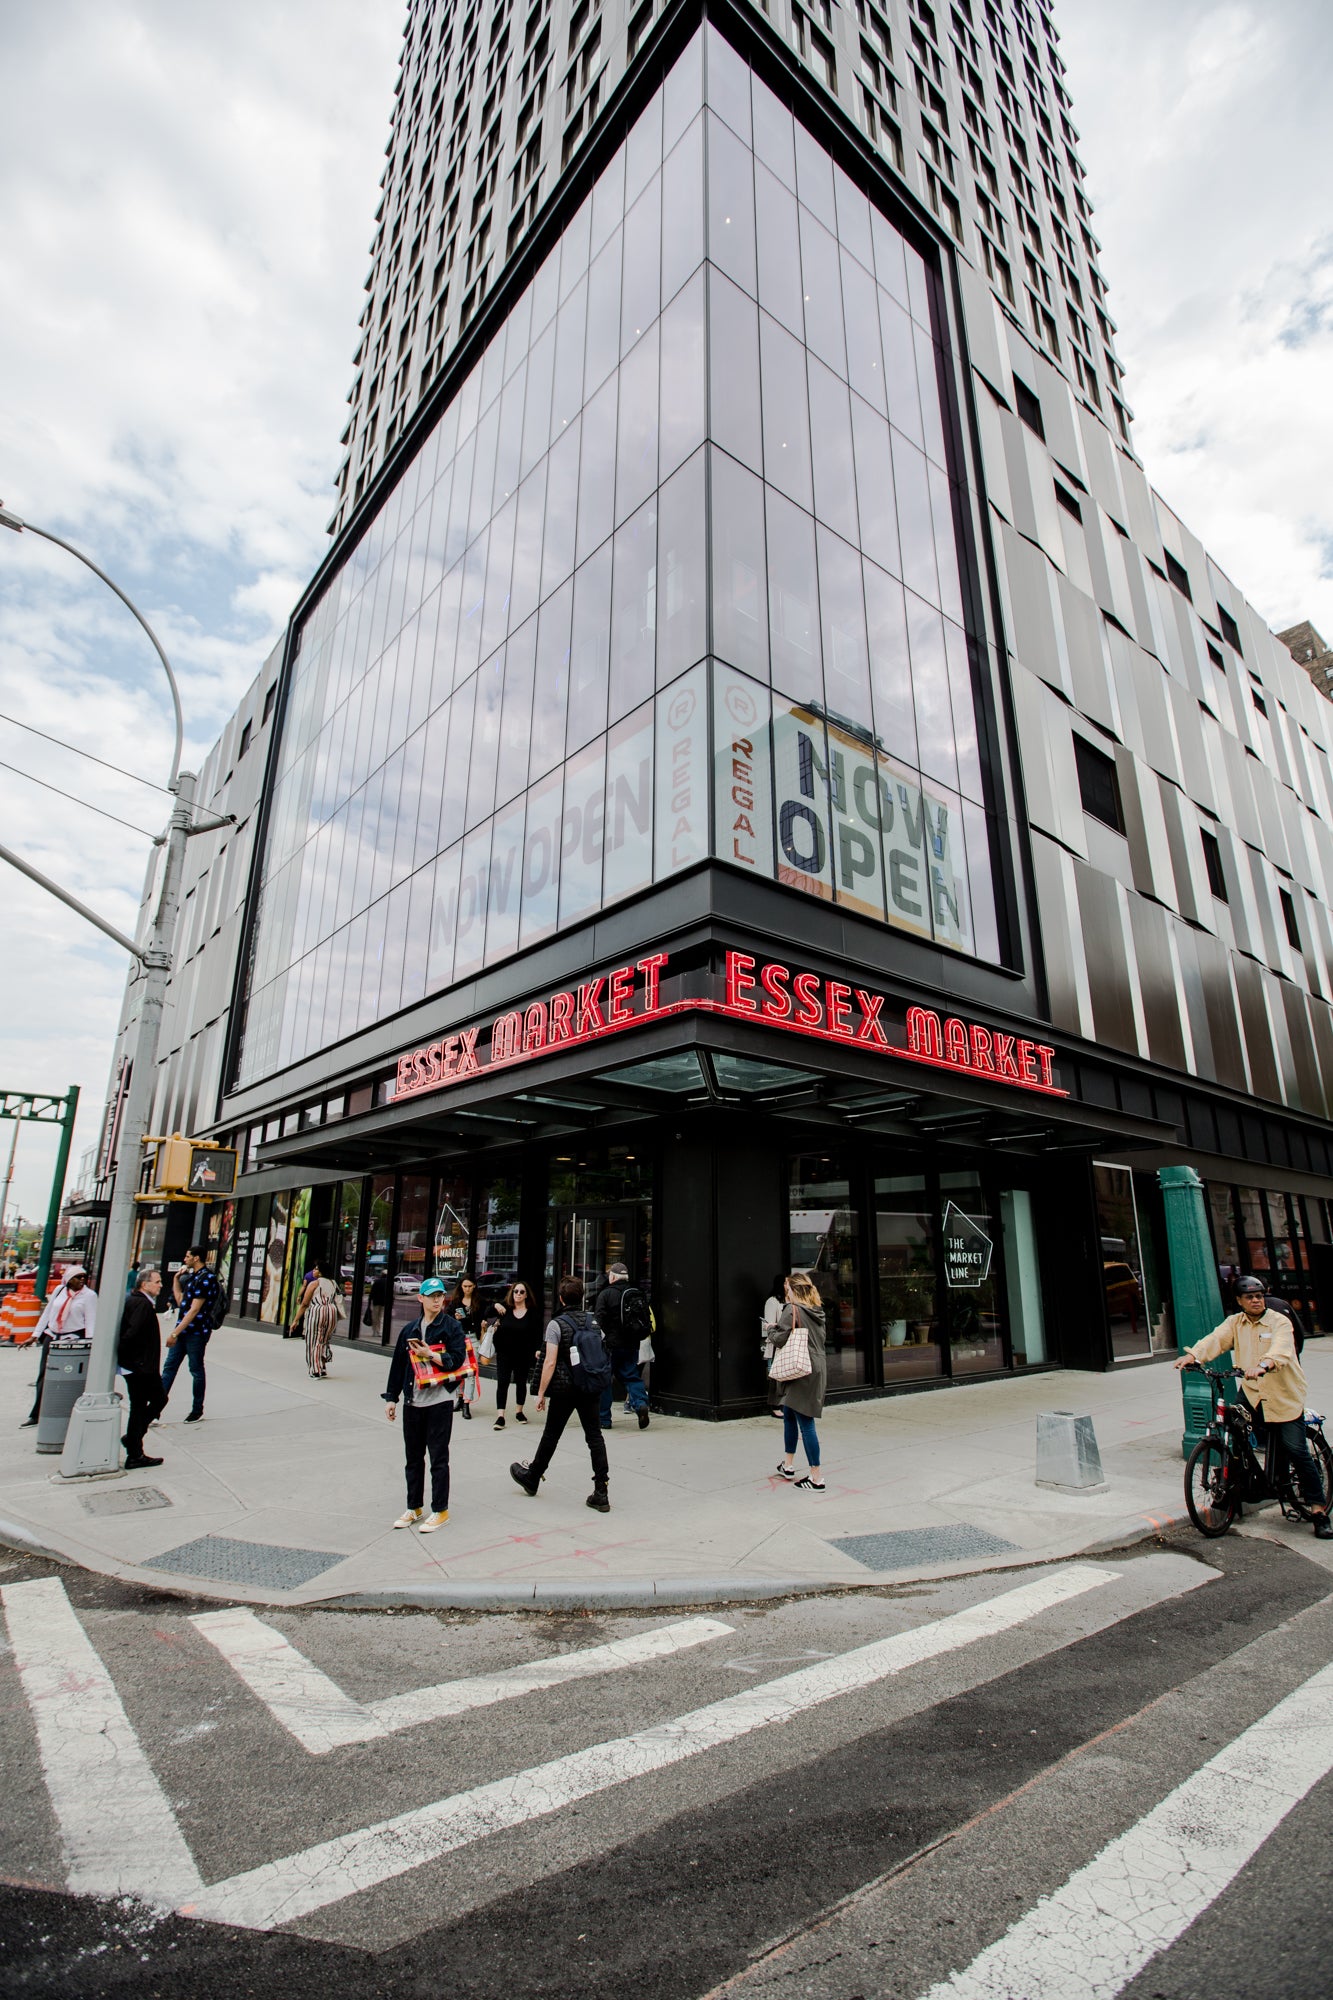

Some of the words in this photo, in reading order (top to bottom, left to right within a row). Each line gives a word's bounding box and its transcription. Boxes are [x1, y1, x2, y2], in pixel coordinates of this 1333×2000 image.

[432, 846, 517, 955] NOW
[523, 756, 650, 899] OPEN
[671, 737, 692, 869] REGAL
[731, 732, 755, 865] REGAL
[797, 730, 948, 862] NOW
[779, 799, 967, 937] OPEN
[396, 1026, 480, 1094] ESSEX
[491, 951, 669, 1062] MARKET
[726, 950, 888, 1044] ESSEX
[906, 1006, 1056, 1086] MARKET
[439, 1261, 452, 1271] LINE
[440, 1247, 465, 1258] MARKET
[441, 1235, 452, 1246] THE
[948, 1237, 965, 1250] THE
[949, 1252, 983, 1264] MARKET
[950, 1266, 969, 1280] LINE
